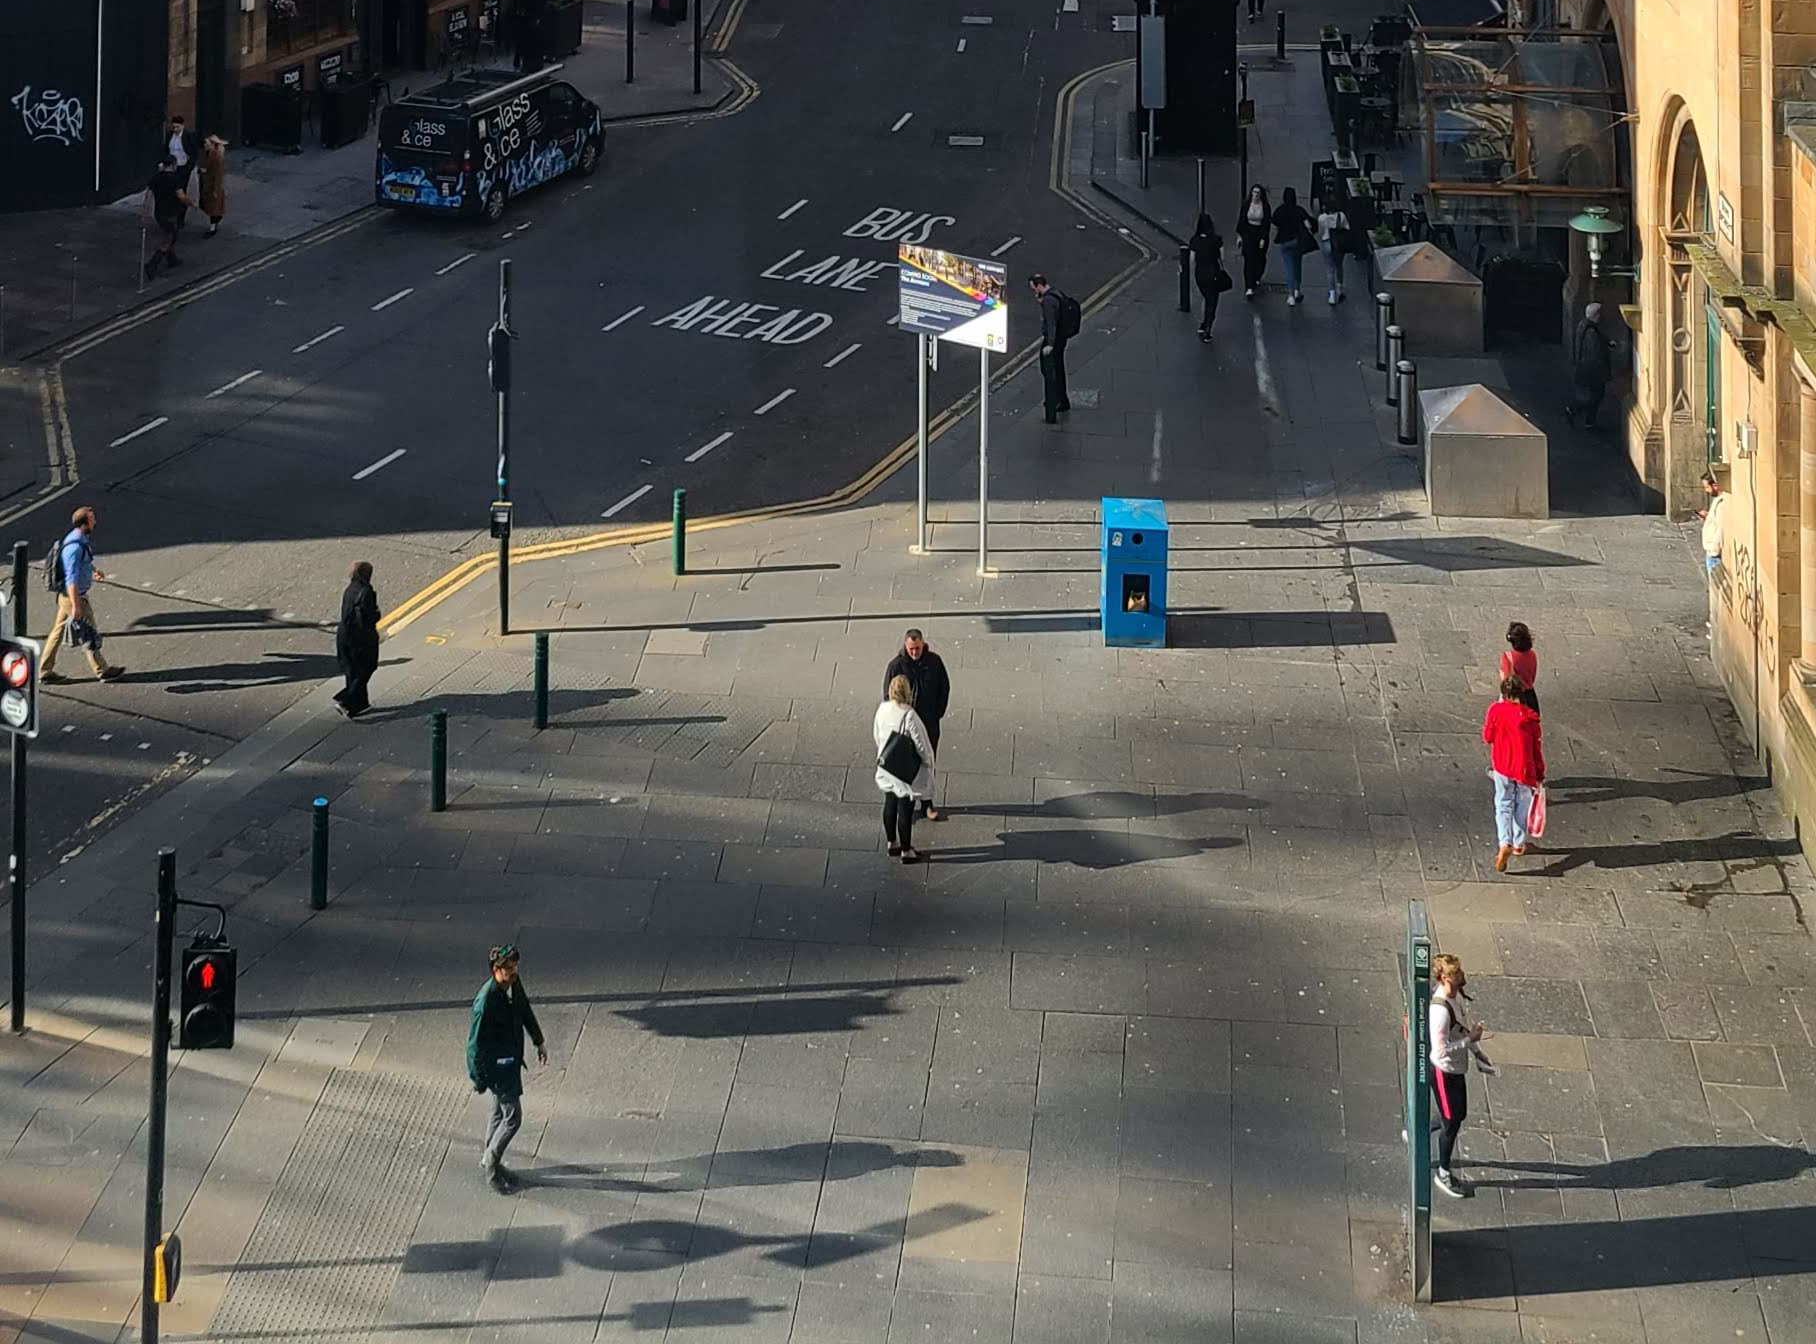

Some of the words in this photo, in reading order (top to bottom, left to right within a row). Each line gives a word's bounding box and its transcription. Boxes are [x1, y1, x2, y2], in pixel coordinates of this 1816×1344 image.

[842, 207, 956, 244] BUS
[760, 249, 899, 292] LANE
[651, 296, 833, 344] AHEAD
